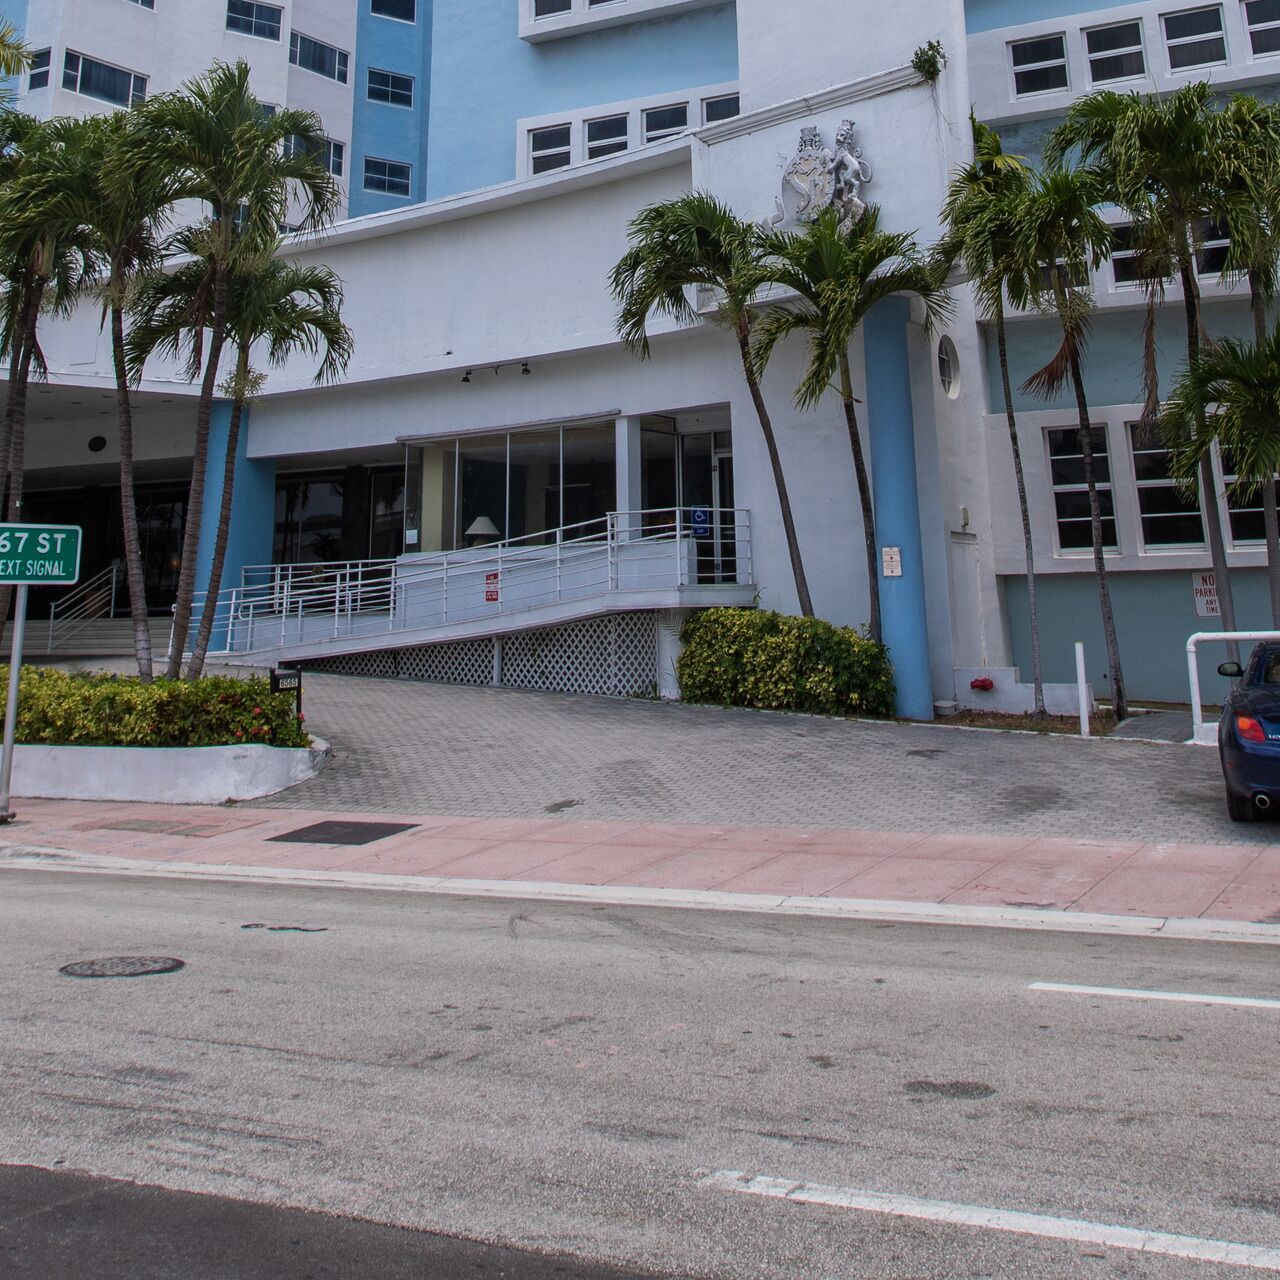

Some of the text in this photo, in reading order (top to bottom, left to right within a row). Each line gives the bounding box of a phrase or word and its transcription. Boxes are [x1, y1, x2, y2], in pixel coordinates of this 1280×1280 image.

[37, 533, 66, 554] ST
[26, 560, 66, 576] SIGNAL
[1201, 574, 1215, 586] NO
[1195, 587, 1218, 598] PARKI
